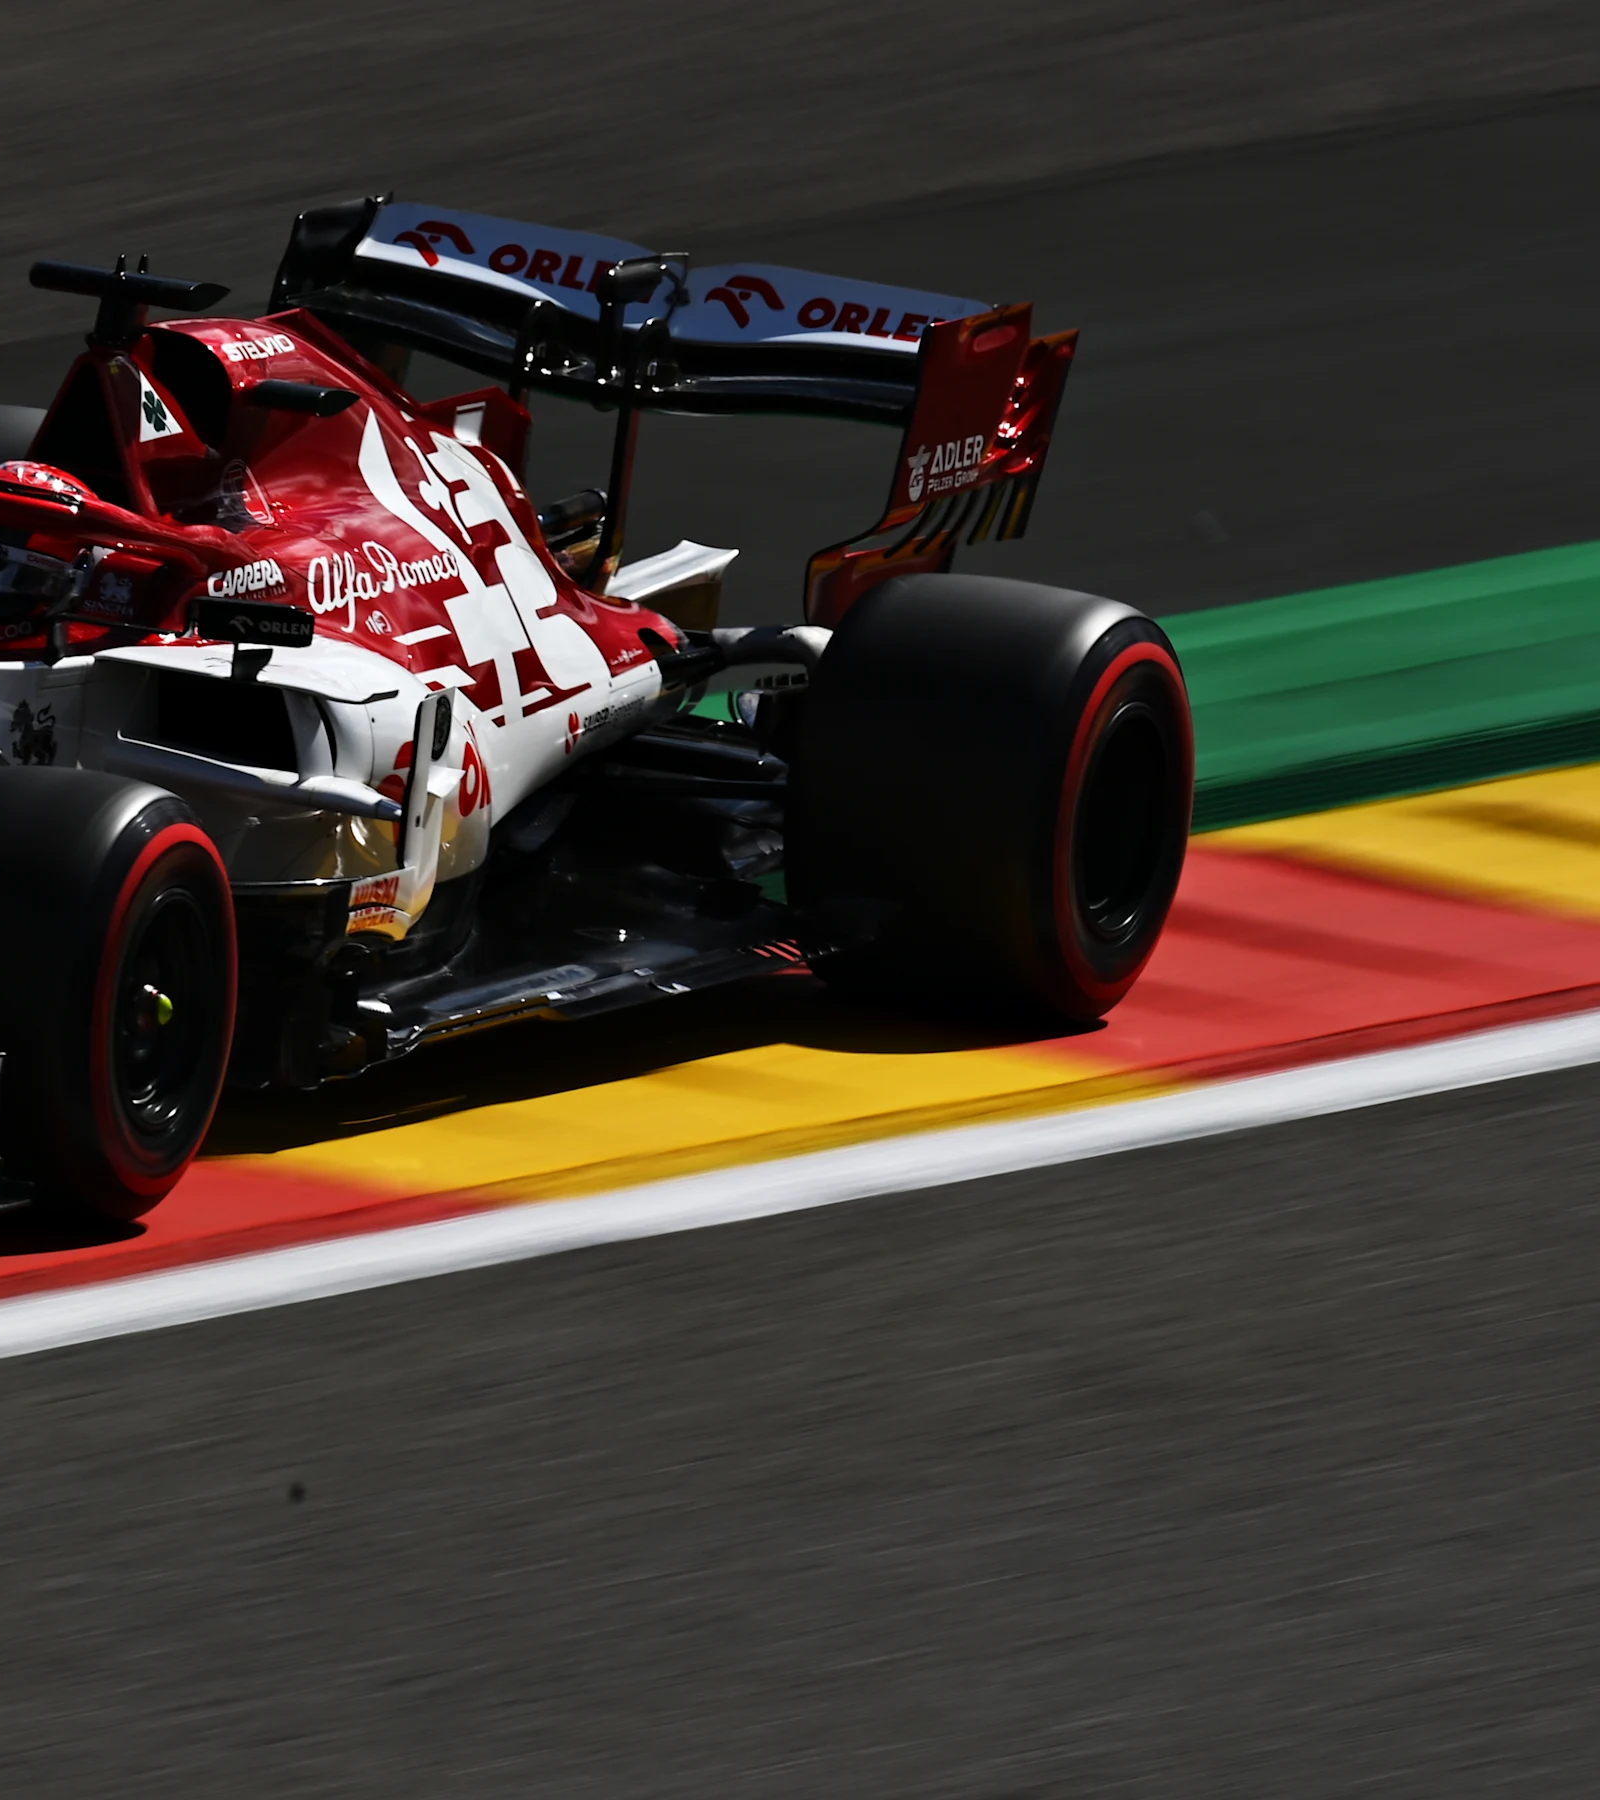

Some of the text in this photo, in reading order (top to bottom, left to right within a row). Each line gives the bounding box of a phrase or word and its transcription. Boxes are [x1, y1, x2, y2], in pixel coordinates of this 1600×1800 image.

[796, 297, 948, 343] ORLE
[221, 333, 296, 362] STELVIO
[929, 434, 985, 476] ADLER
[207, 557, 285, 598] CARRERA
[307, 540, 461, 633] Alfa Romeo
[259, 619, 311, 636] ORLEN
